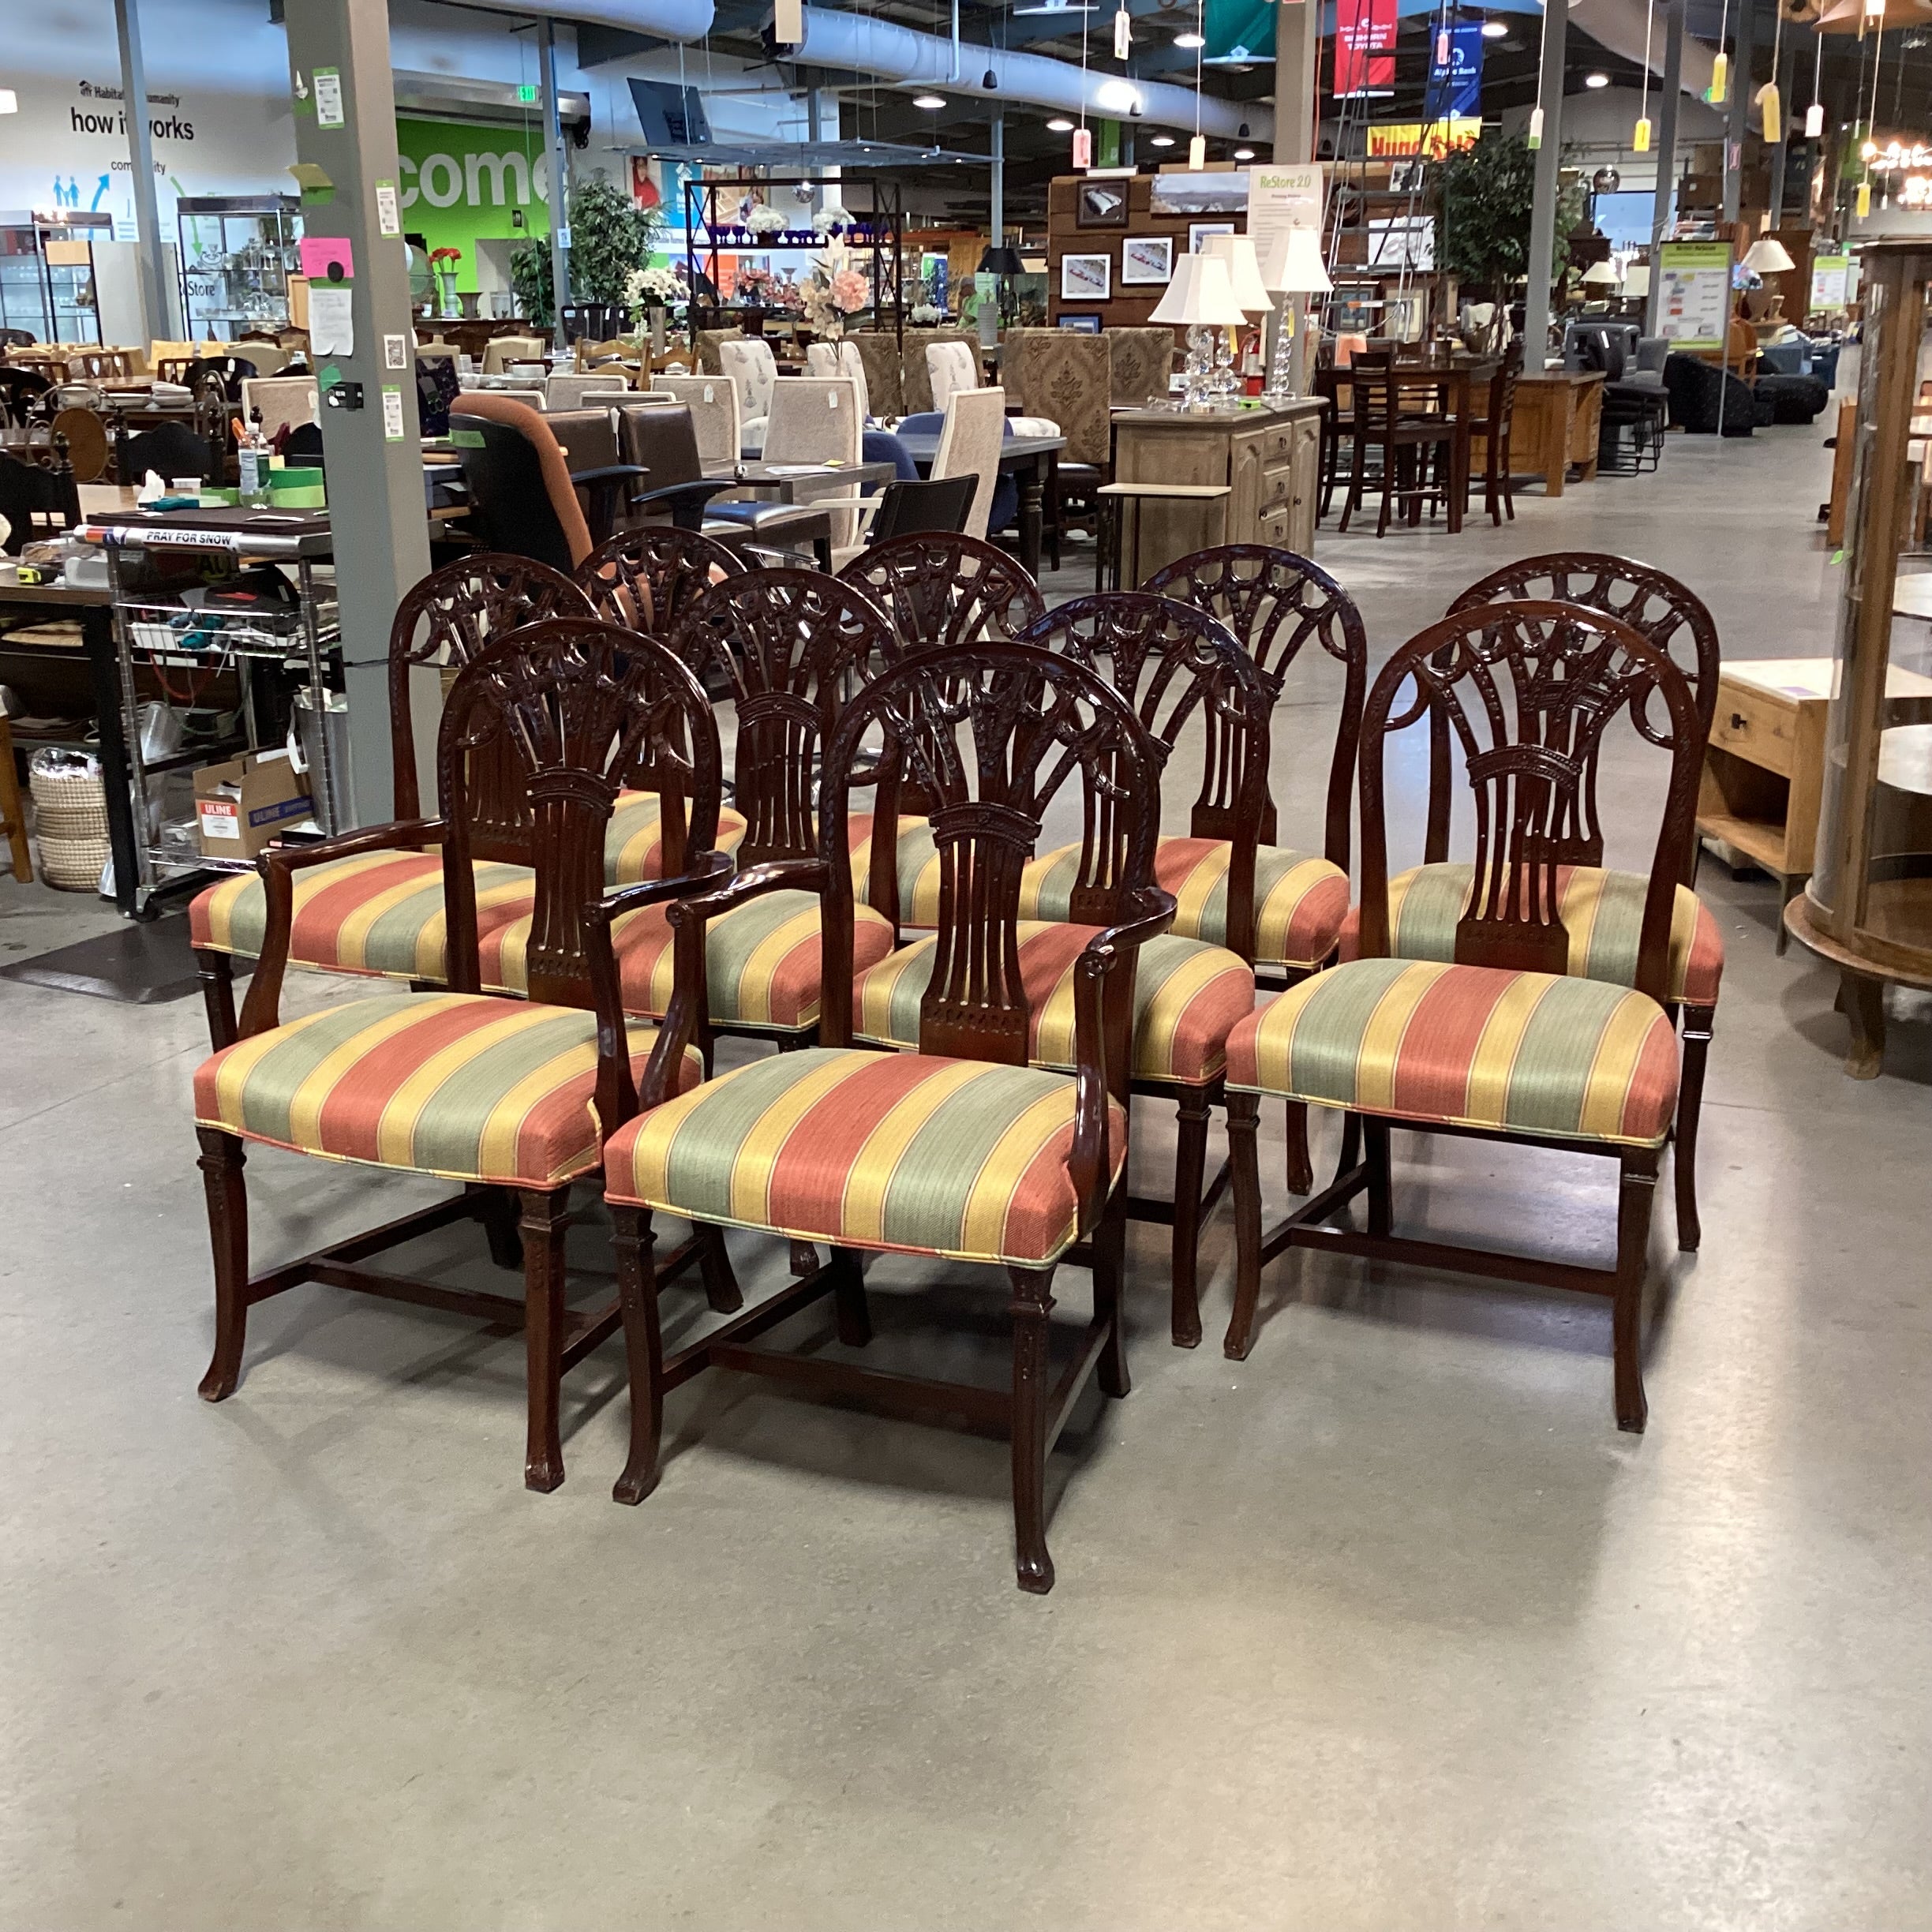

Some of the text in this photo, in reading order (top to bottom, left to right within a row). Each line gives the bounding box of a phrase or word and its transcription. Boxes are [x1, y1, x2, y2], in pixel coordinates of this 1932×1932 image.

[70, 107, 114, 134] how
[1260, 174, 1312, 189] ReStore 2.0
[147, 531, 232, 545] PRAY FOR SNOW
[204, 803, 232, 816] ULINE
